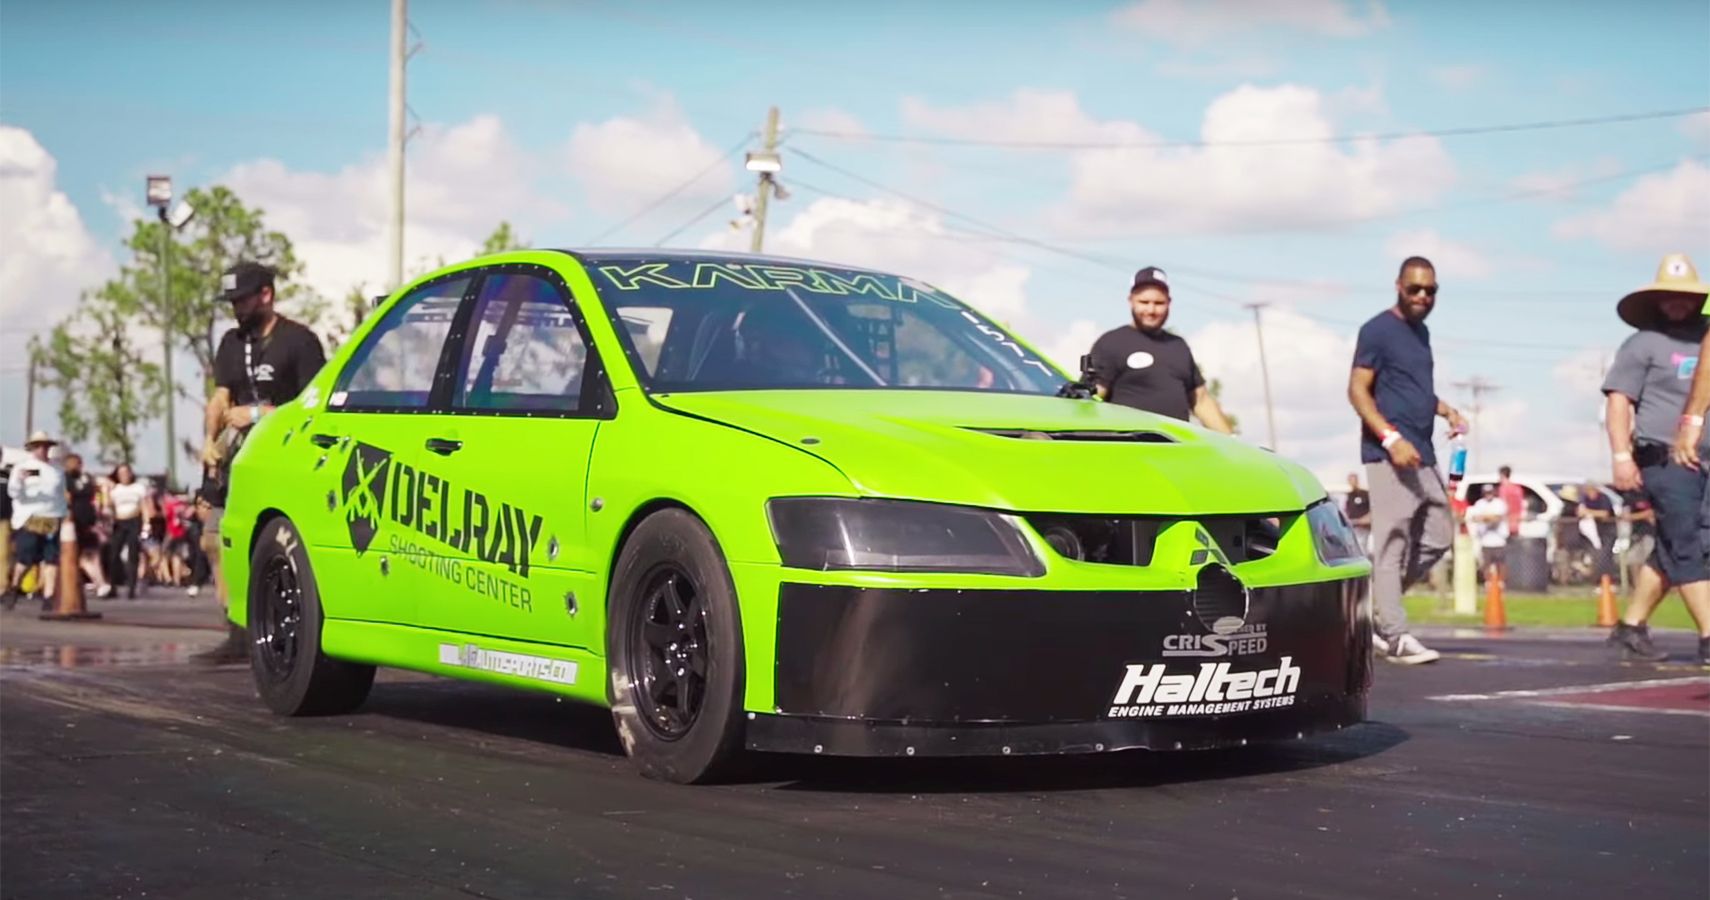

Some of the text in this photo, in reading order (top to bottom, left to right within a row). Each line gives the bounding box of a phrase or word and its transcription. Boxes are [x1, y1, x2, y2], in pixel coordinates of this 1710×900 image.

[600, 264, 961, 309] KARMA
[391, 462, 543, 578] DELRAY
[388, 534, 533, 613] SHOOTING CENTER
[1113, 656, 1301, 704] Haltech
[1108, 695, 1295, 717] ENGINE MANAGEMENT SYSTEMS
